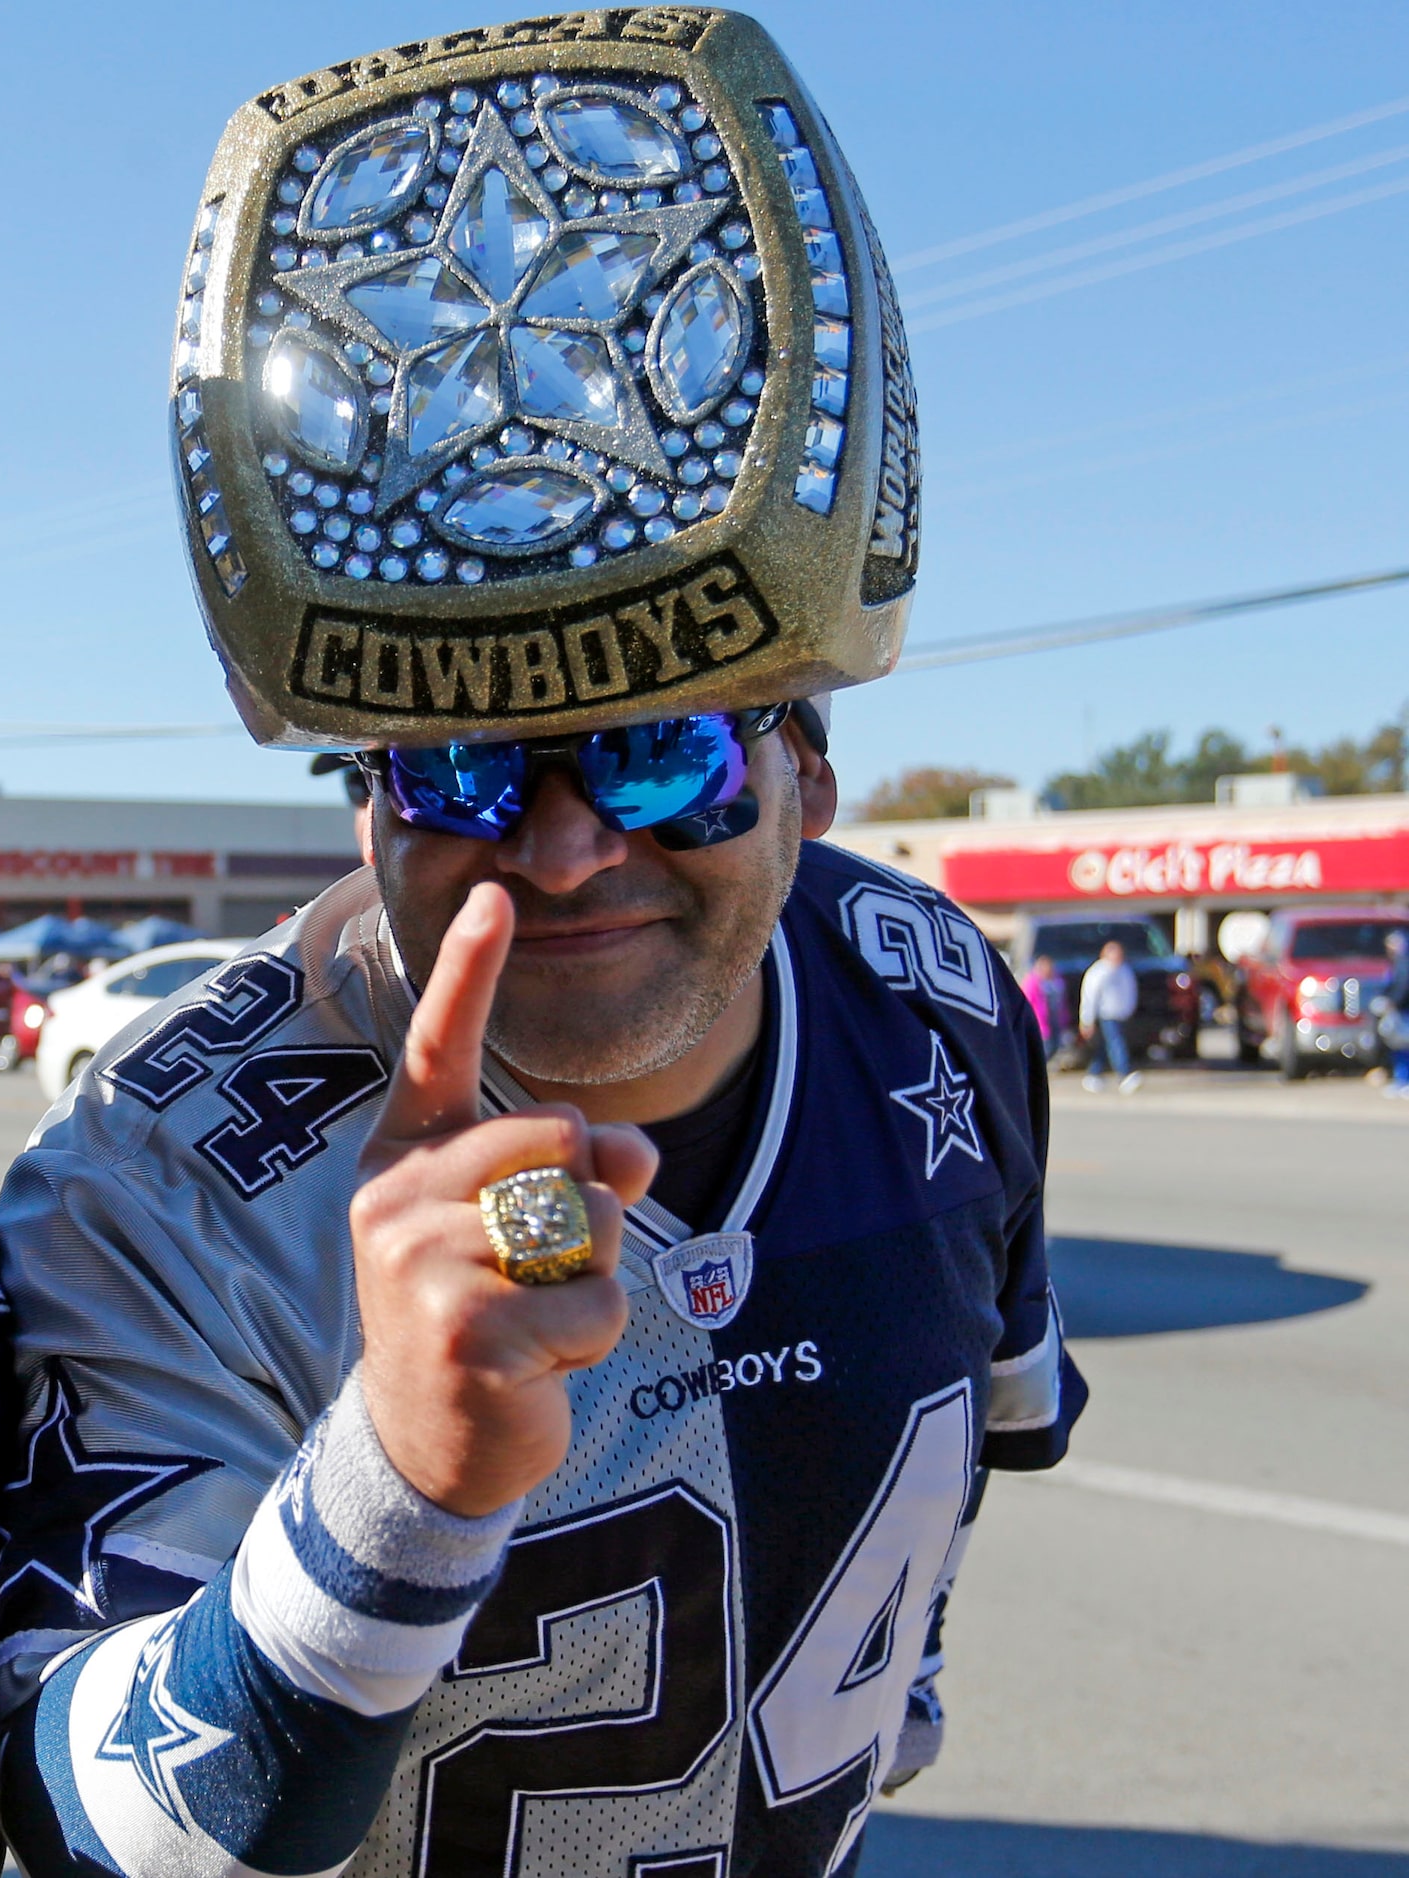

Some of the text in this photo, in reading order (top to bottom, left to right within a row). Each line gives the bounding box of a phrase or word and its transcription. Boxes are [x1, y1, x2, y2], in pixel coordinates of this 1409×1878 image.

[301, 565, 767, 704] COWBOYS
[95, 951, 390, 1202] 24
[691, 1281, 736, 1314] NFL
[630, 1340, 823, 1420] COWBOYS
[416, 1376, 976, 1878] 24
